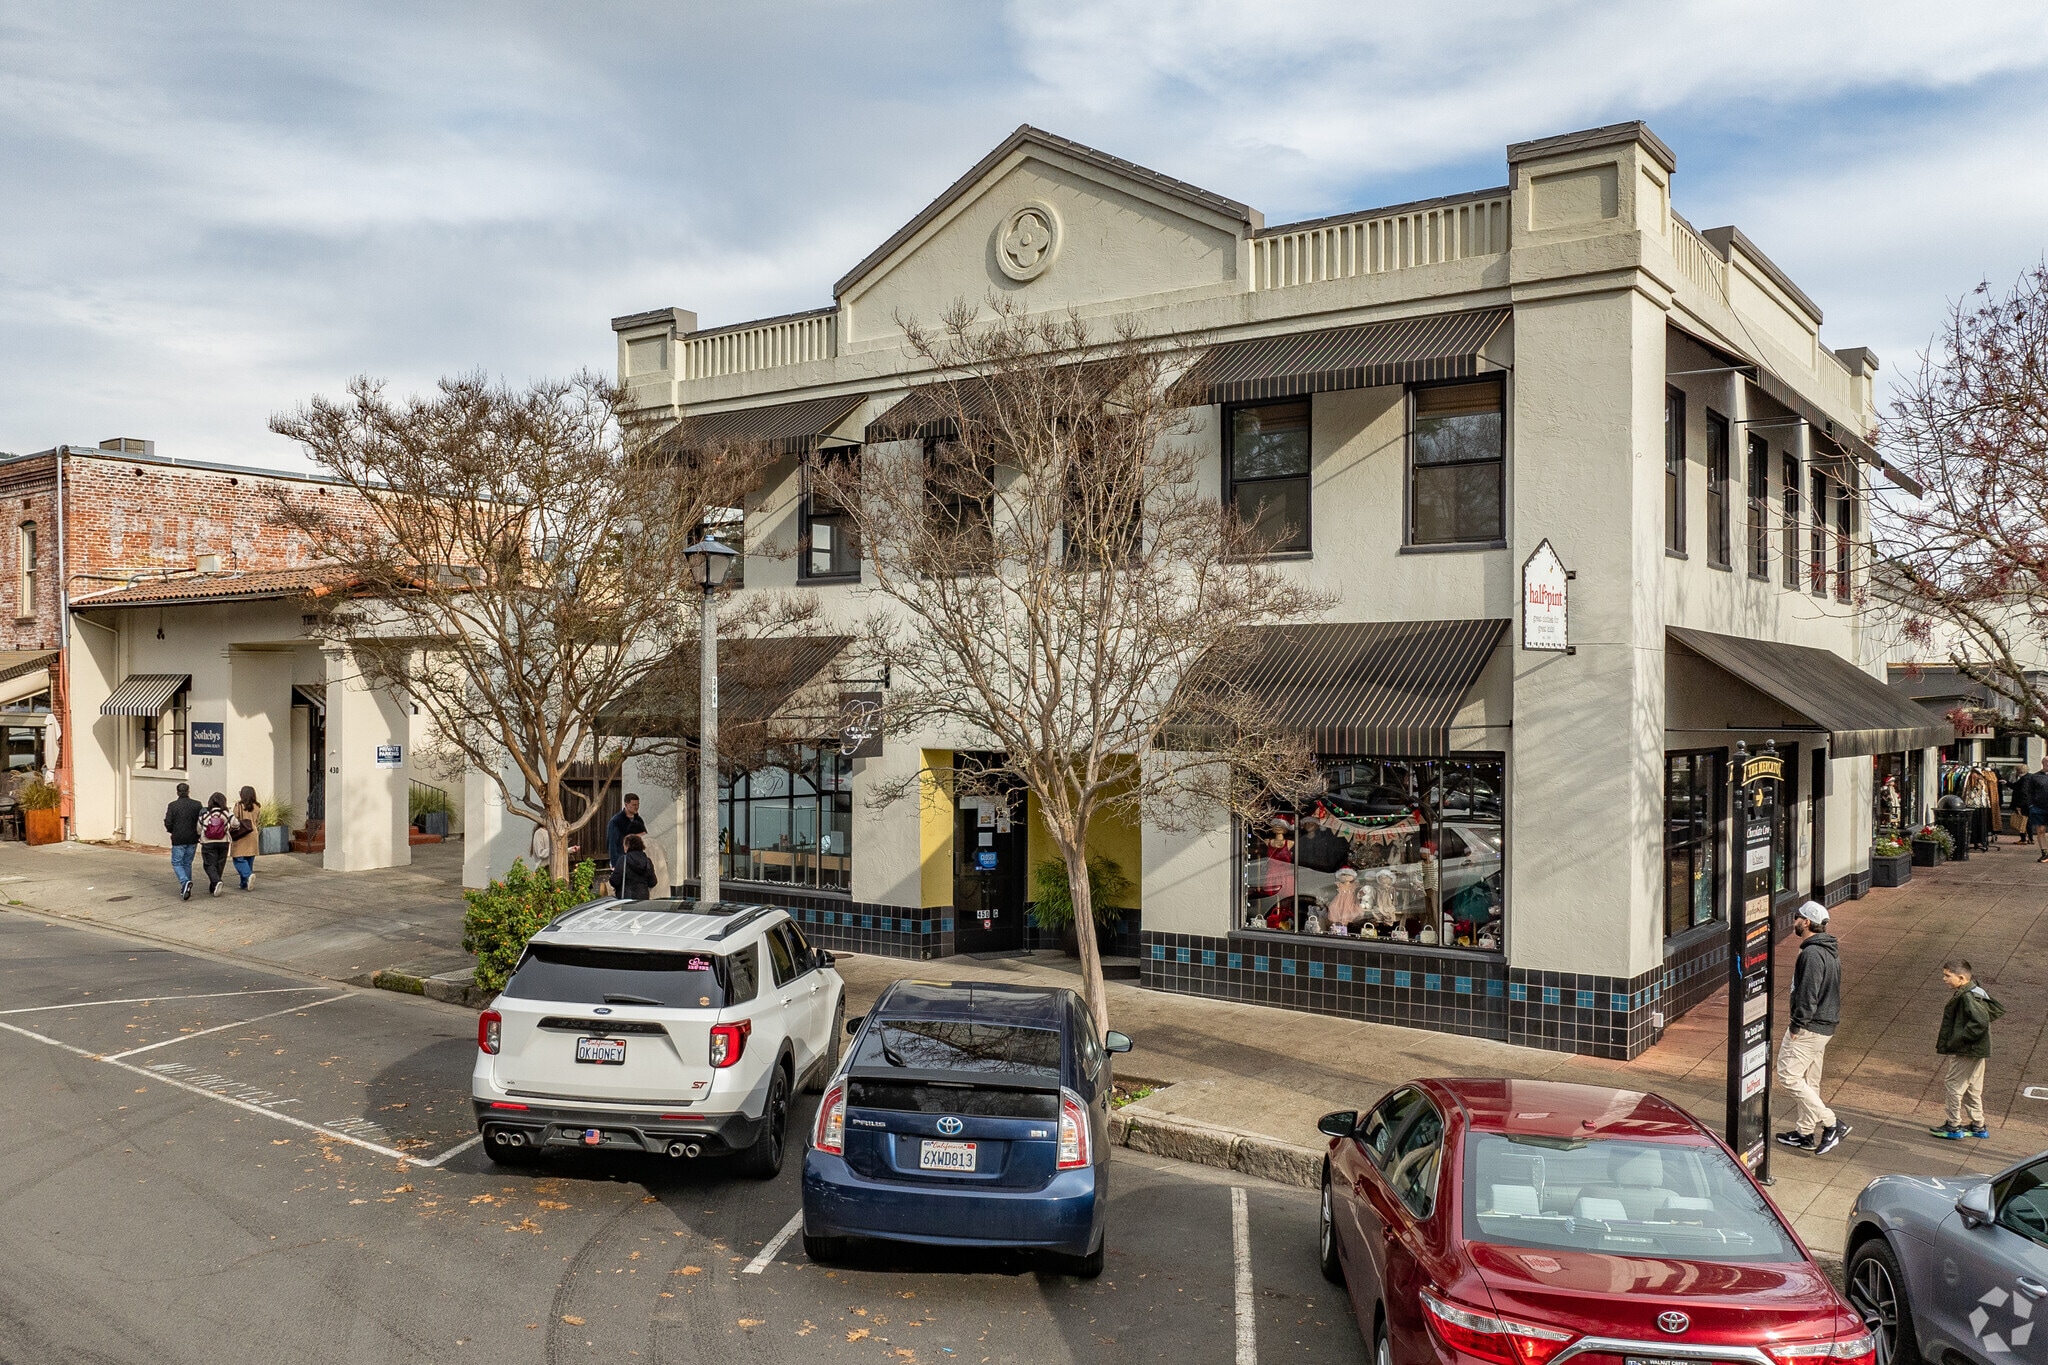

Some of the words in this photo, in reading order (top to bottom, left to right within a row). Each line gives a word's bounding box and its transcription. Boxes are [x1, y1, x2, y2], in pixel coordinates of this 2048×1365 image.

[194, 729, 221, 743] Sotheby's
[329, 766, 340, 774] 430
[1747, 762, 1758, 778] THE
[691, 1081, 708, 1089] ST
[852, 1118, 886, 1127] PRIUS
[932, 1141, 964, 1151] California
[923, 1150, 973, 1167] 6XWD813
